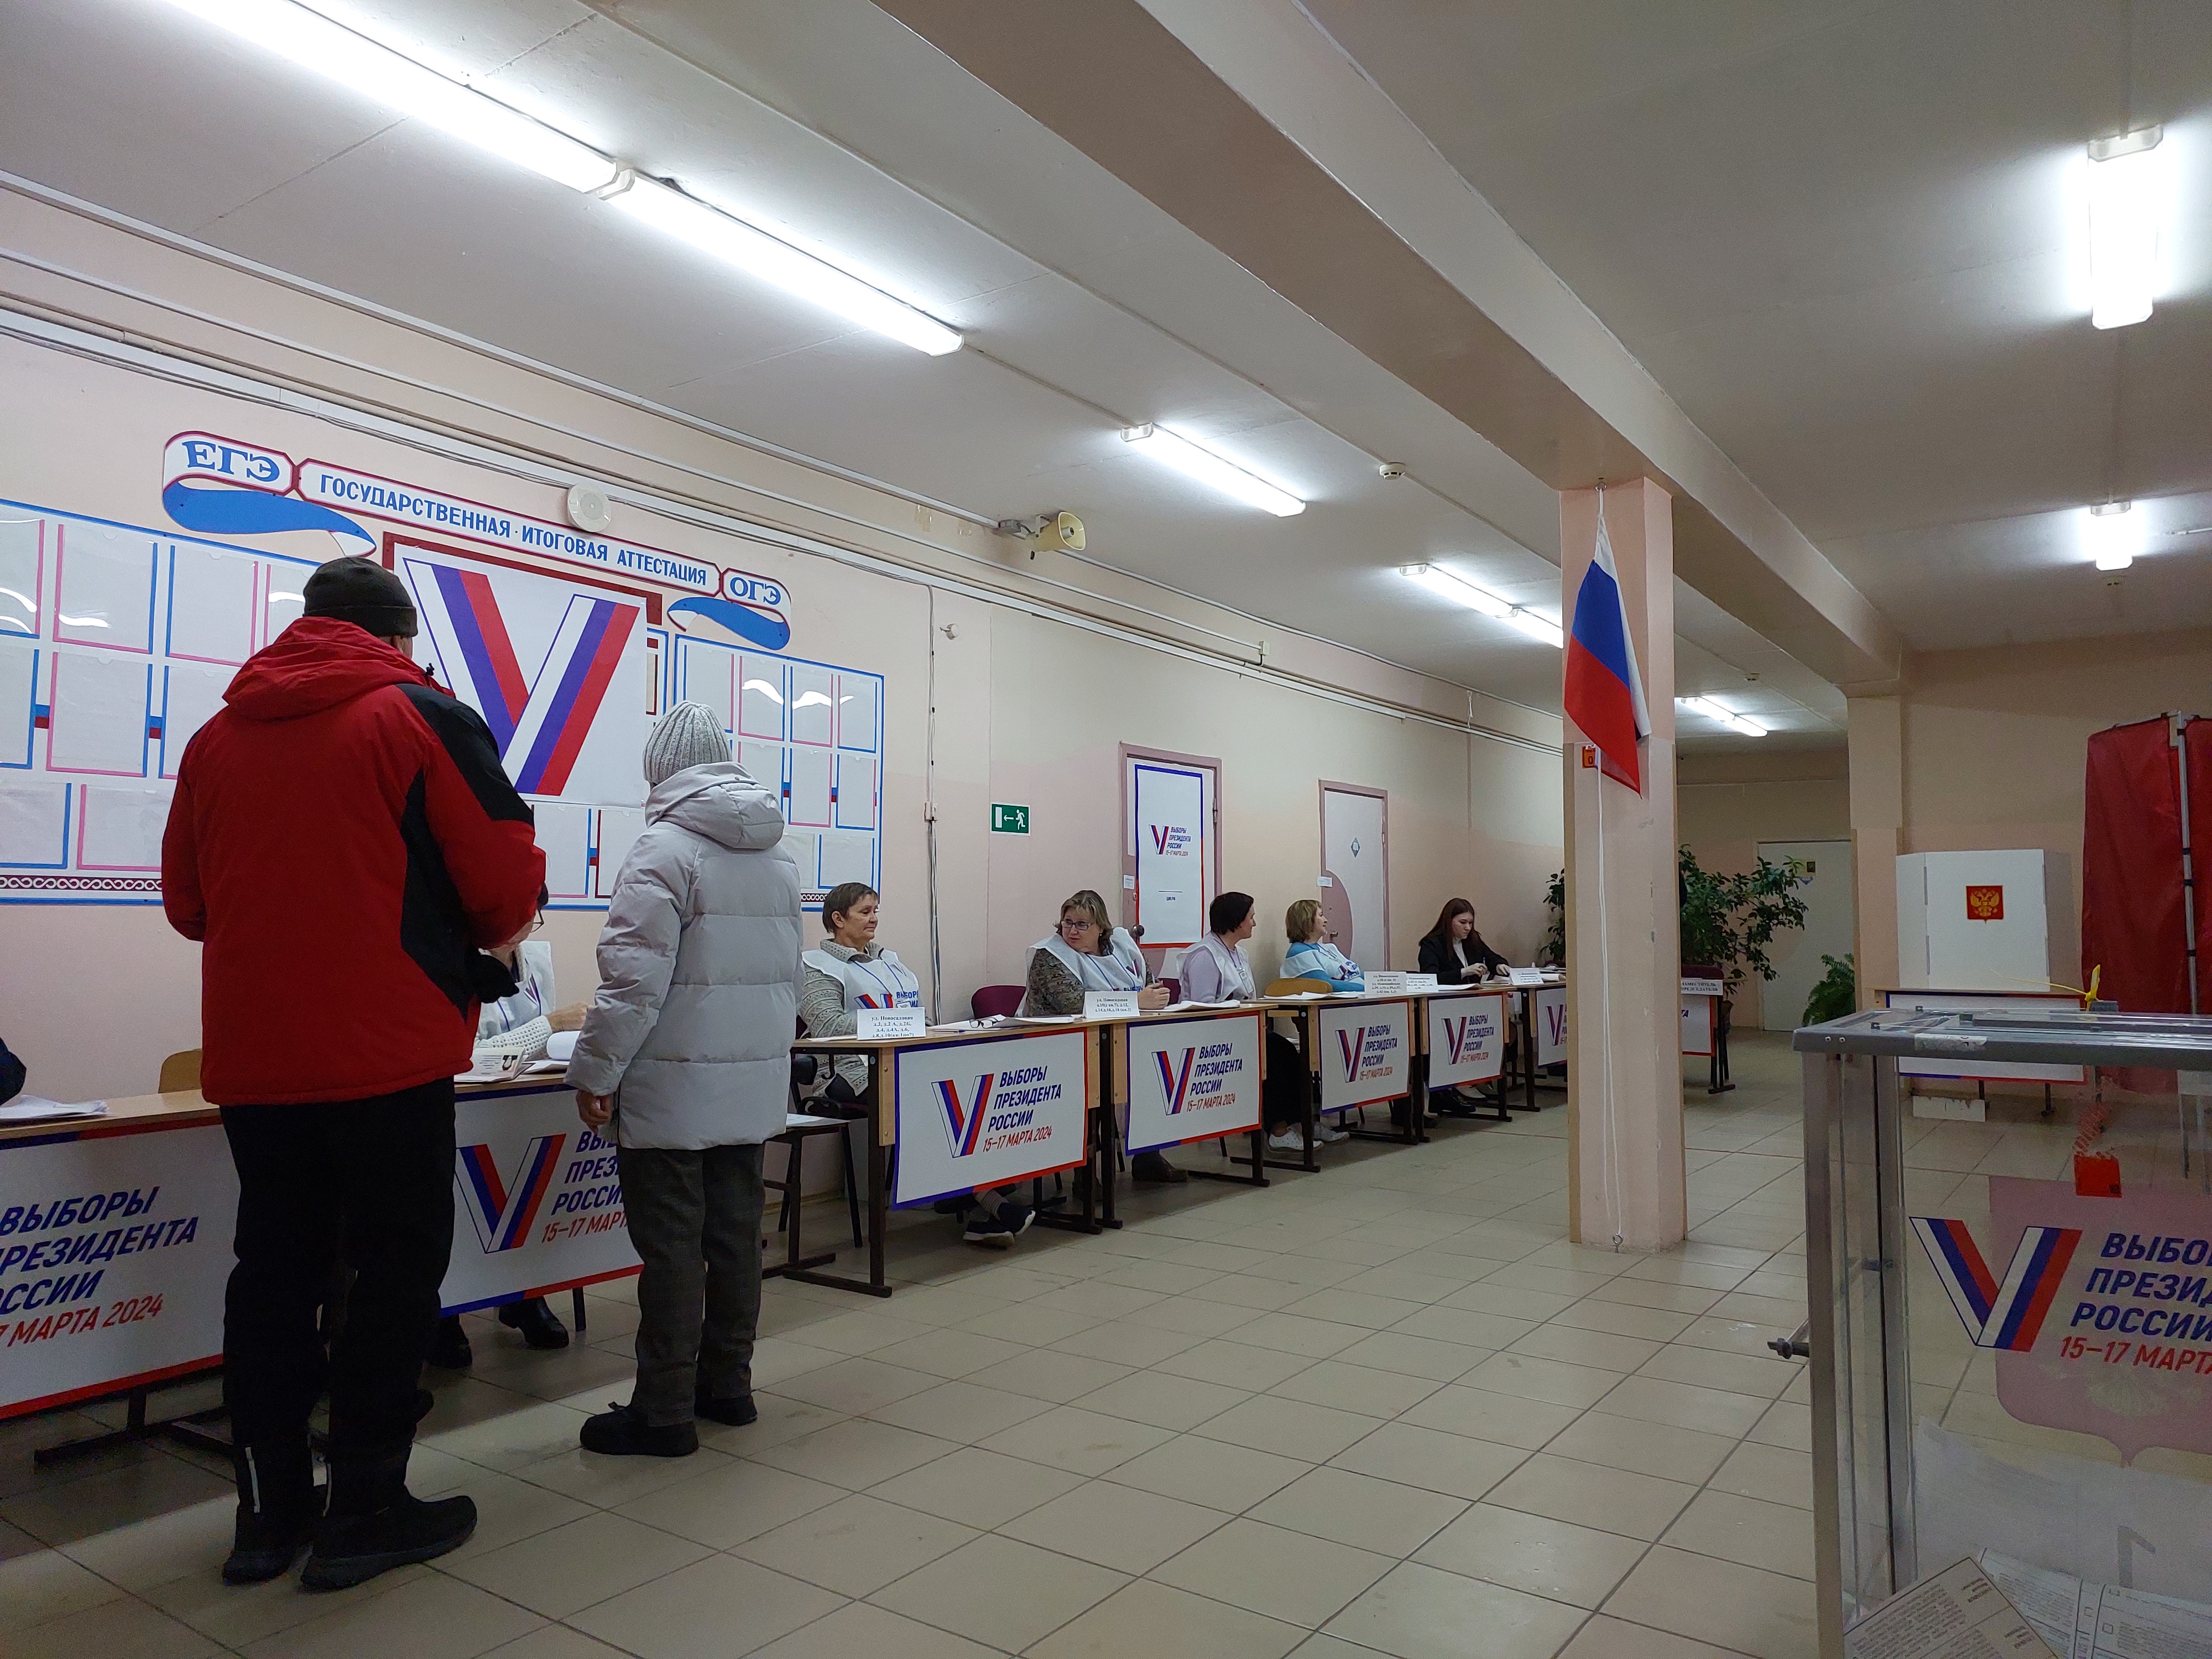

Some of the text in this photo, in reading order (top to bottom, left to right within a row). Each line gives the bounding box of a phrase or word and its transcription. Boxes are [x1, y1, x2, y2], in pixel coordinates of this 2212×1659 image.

[182, 441, 280, 482] ЕГЭ
[321, 474, 706, 586] ГОСУДАРСТВЕННАЯ ИТОГОВАЯ АТТЕСТАЦИЯ
[730, 577, 781, 605] ОГЭ
[896, 990, 918, 999] ВЫБОР
[1368, 1024, 1390, 1037] ВЫБОРЫ
[1469, 1014, 1488, 1025] ВЫБОРЫ
[1467, 1026, 1494, 1039] ПРЕЗИДЕНТА
[1199, 1042, 1232, 1059] ВЫБОРЫ
[1364, 1037, 1397, 1052] ПРЕЗИДЕНТА
[1463, 1041, 1483, 1052] РОССИИ
[1194, 1058, 1242, 1077] ПРЕЗИДЕНТА
[1361, 1054, 1384, 1067] РОССИИ
[999, 1066, 1047, 1087] ВЫБОРЫ
[1370, 1068, 1383, 1079] МАРТА
[994, 1084, 1061, 1109] ПРЕЗИДЕНТА
[1190, 1079, 1222, 1096] РОССИИ
[1203, 1095, 1222, 1109] МАРТА
[1223, 1093, 1235, 1105] 2024
[988, 1109, 1034, 1133] РОССИИ
[1006, 1129, 1033, 1147] МАРТА
[1034, 1125, 1052, 1141] 2024
[0, 1186, 160, 1236] ВЫБОРЫ
[551, 1185, 623, 1215] РОССИ
[585, 1211, 627, 1234] МАРТ
[0, 1217, 199, 1276] РЕЗИДЕНТА
[2101, 1233, 2212, 1267] ВЫБО
[0, 1269, 105, 1315] ССИИ
[2085, 1267, 2212, 1308] ПРЕЗИ
[7, 1293, 163, 1348] МАРТА 2024
